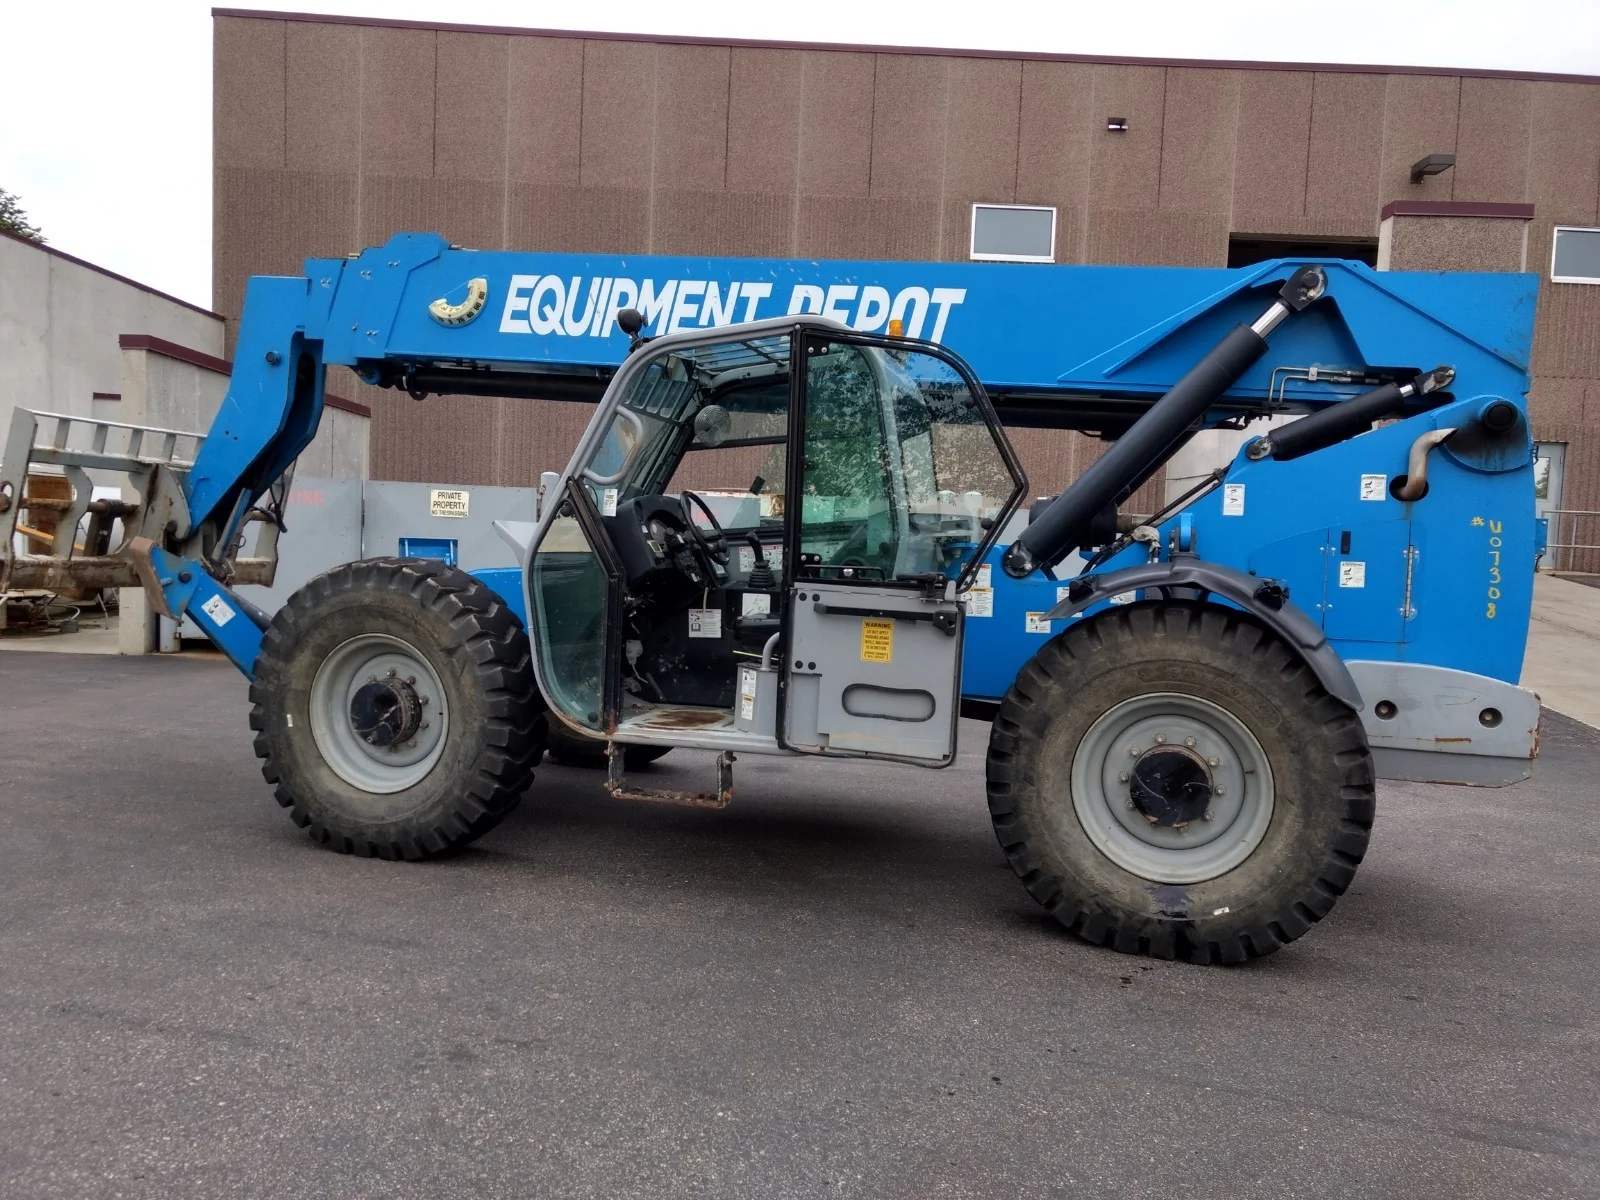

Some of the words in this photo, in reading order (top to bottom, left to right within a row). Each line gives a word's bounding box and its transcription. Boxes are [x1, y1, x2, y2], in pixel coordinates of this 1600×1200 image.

[499, 274, 774, 339] EQUIPMENT
[787, 285, 968, 346] DEPOT
[438, 491, 462, 500] PRIVATE
[432, 501, 466, 510] PROPERTY
